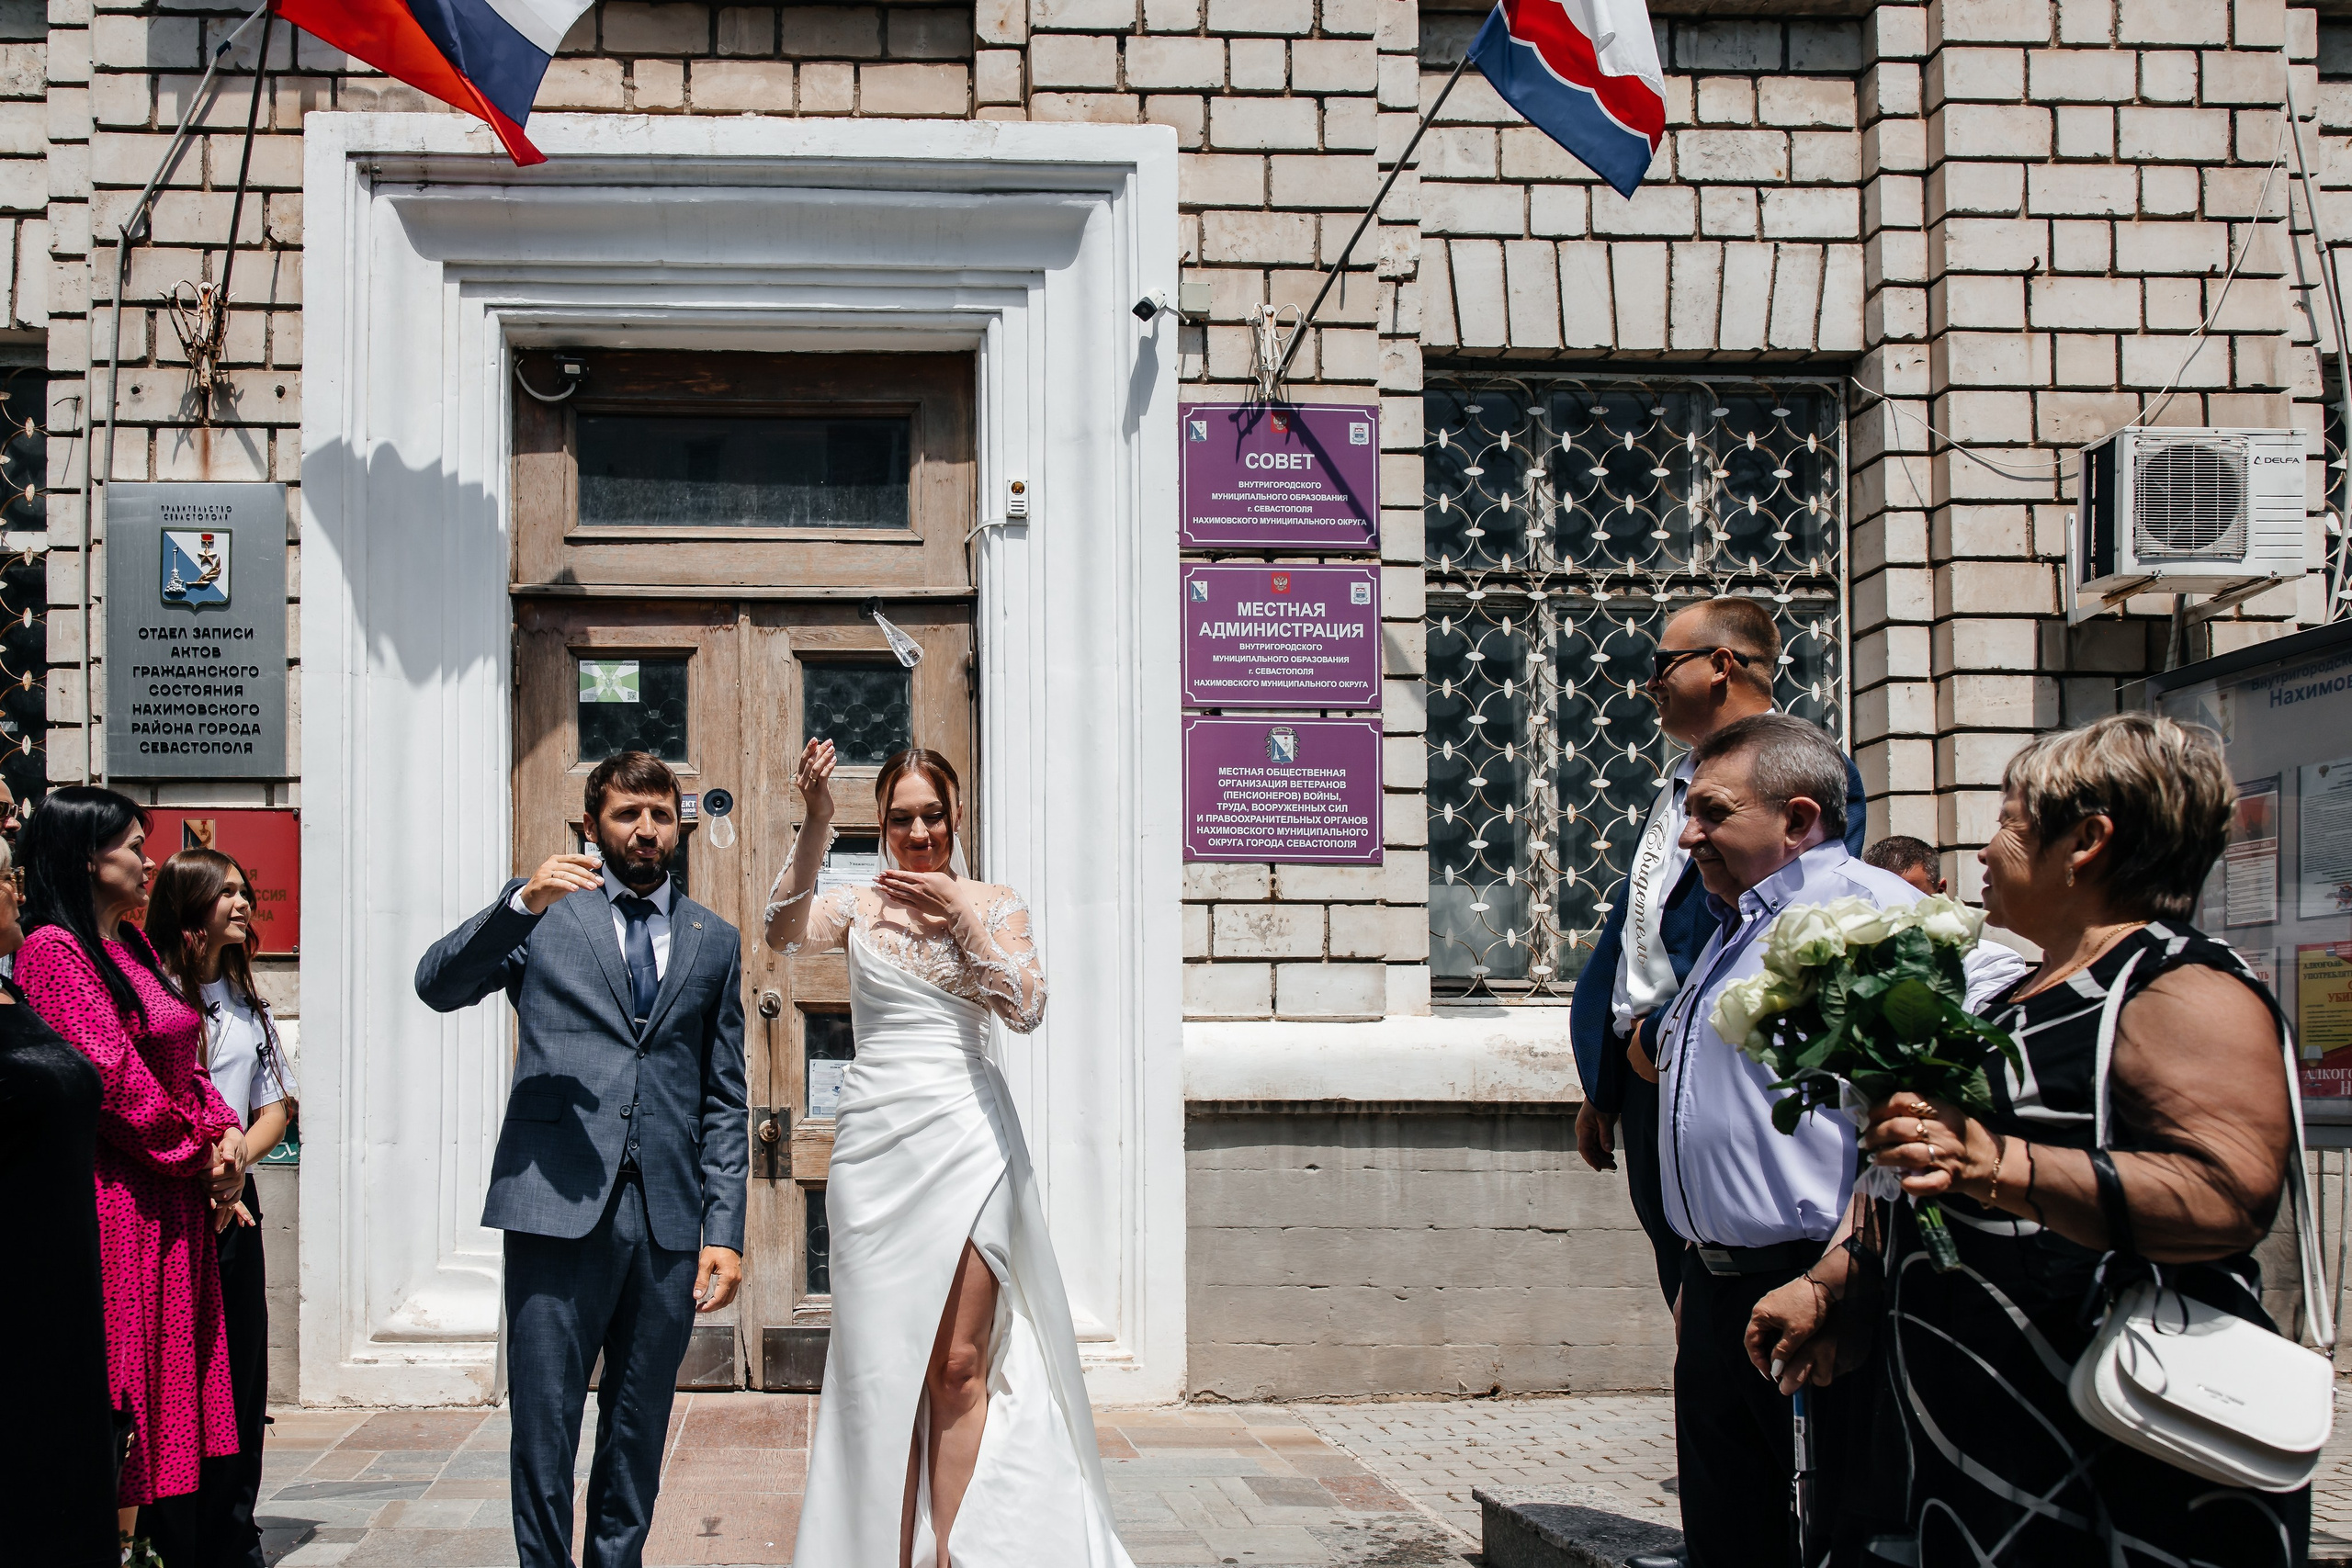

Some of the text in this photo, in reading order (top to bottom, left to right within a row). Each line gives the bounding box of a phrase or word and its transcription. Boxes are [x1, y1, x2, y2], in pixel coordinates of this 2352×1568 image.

[1246, 453, 1315, 469] СОВЕТ
[1238, 481, 1321, 490] ВНУТРИГОРОДСКОГО
[1212, 493, 1348, 502] МУНИЦИПАЛЬНОГО ОБРАЗОВАНИЯ
[1254, 505, 1312, 513] СЕВАСТОПОЛЯ
[1260, 517, 1335, 526] МУНИЦИПАЛЬНОГО
[1338, 518, 1366, 526] ОКРУГА
[1238, 602, 1325, 617] МЕСТНАЯ
[139, 627, 254, 640] ОТДЕЛ ЗАПИСИ
[1199, 623, 1363, 640] АДМИНИСТРАЦИЯ
[1239, 643, 1322, 651] ВНУТРИГОРОДСКОГО
[171, 647, 220, 659] АКТОВ
[1213, 655, 1289, 664] МУНИЦИПАЛЬНОГО
[133, 665, 259, 679] ГРАЖДАНСКОГО
[1194, 679, 1259, 687] НАХИМОВСКОГО
[1261, 680, 1337, 689] МУНИЦИПАЛЬНОГО
[149, 684, 243, 696] СОСТОЯНИЯ
[133, 704, 259, 716] НАХИМОВСКОГО
[132, 720, 261, 736] РАЙОНА ГОРОДА
[140, 741, 253, 754] СЕВАСТОПОЛЯ
[1218, 767, 1346, 777] МЕСТНАЯ ОБЩЕСТВЕННАЯ
[1218, 779, 1346, 789] ОРГАНИЗАЦИЯ ВЕТЕРАНОВ
[1223, 791, 1341, 802] (ПЕНСИОНЕРОВ) ВОЙНЫ,
[1217, 803, 1347, 813] ТРУДА, ВООРУЖЕННЫХ СИЛ
[1206, 815, 1321, 824] ПРАВООХРАНИТЕЛЬНЫХ
[1324, 816, 1368, 824] ОРГАНОВ
[1197, 827, 1368, 837] НАХИМОВСКОГО МУНИЦИПАЛЬНОГО
[1208, 839, 1356, 848] ОКРУГА ГОРОДА СЕВАСТОПОЛЯ
[1632, 810, 1668, 969] Свидетель
[2303, 961, 2343, 970] АЛКОГОЛЬ
